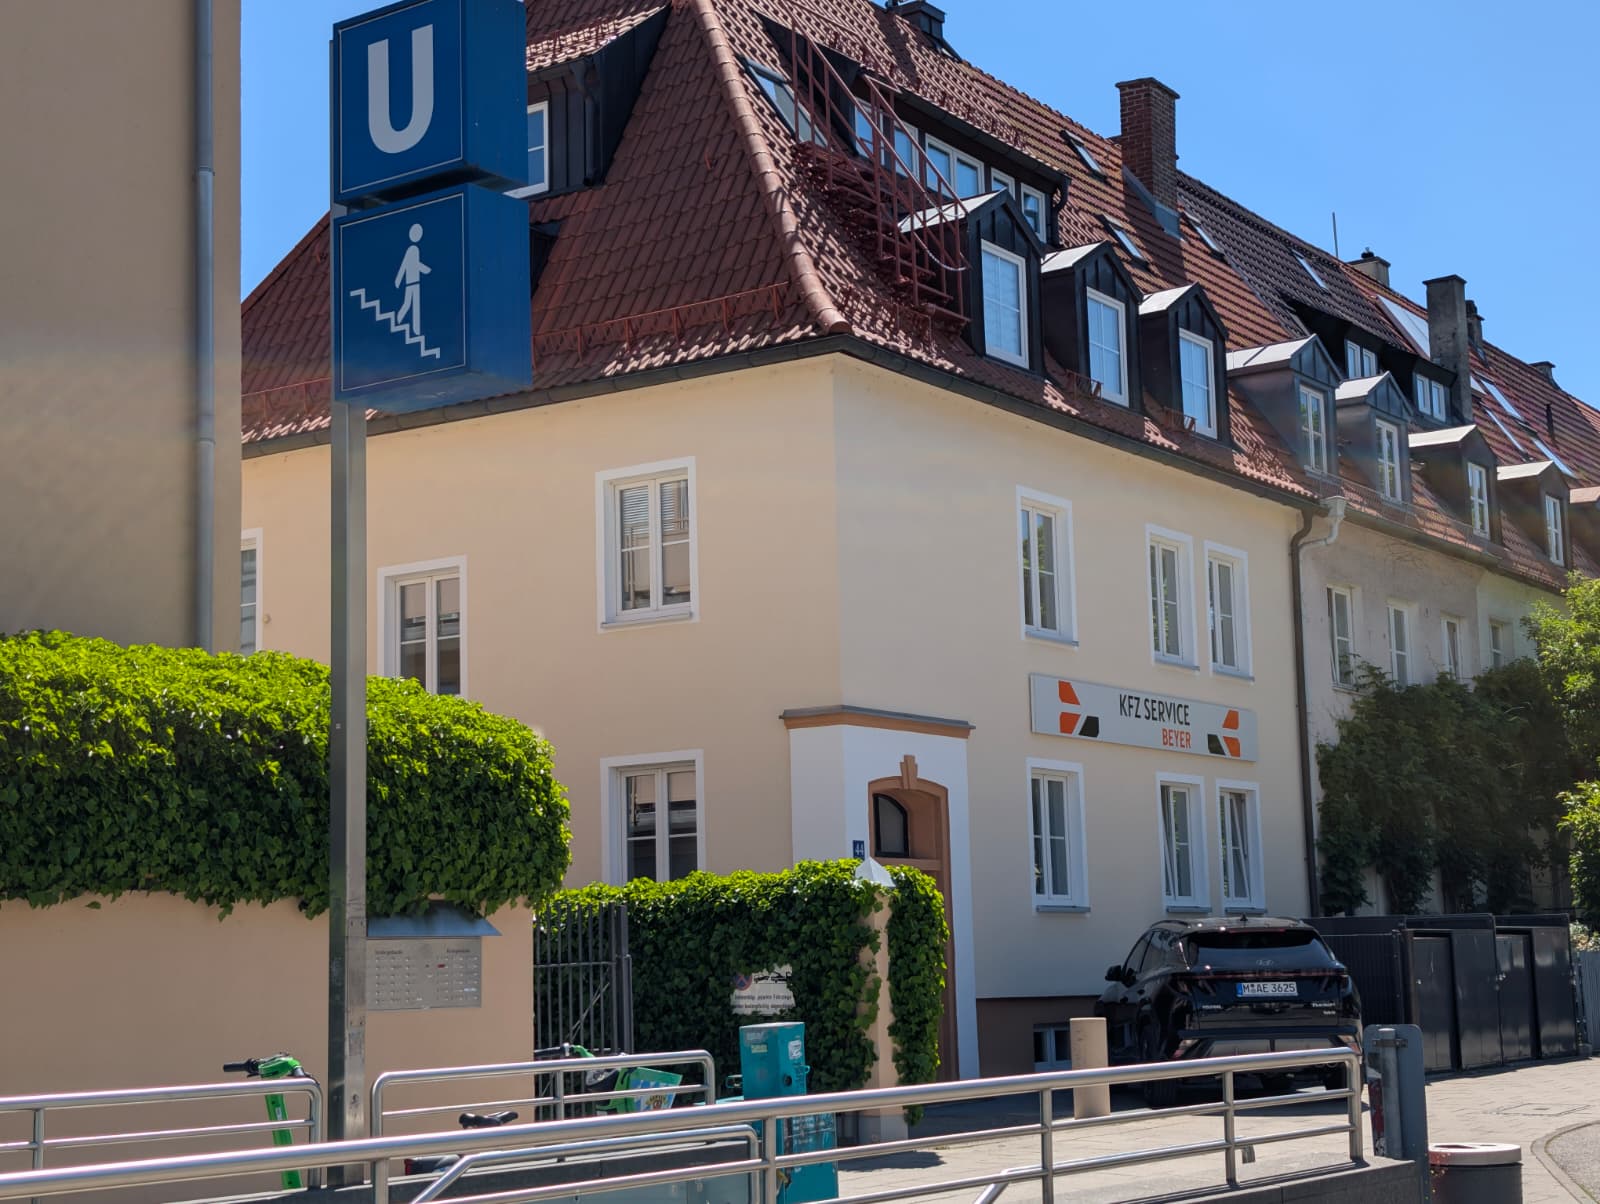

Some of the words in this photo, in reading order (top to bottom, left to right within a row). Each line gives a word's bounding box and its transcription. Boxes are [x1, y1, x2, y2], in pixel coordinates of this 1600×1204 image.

[367, 24, 434, 153] U
[1119, 693, 1142, 719] KFZ
[1144, 698, 1191, 726] SERVICE
[1162, 728, 1192, 749] BEYER
[854, 842, 864, 856] 44
[1242, 983, 1250, 993] M
[1256, 983, 1270, 993] AE
[1271, 983, 1296, 993] 3625
